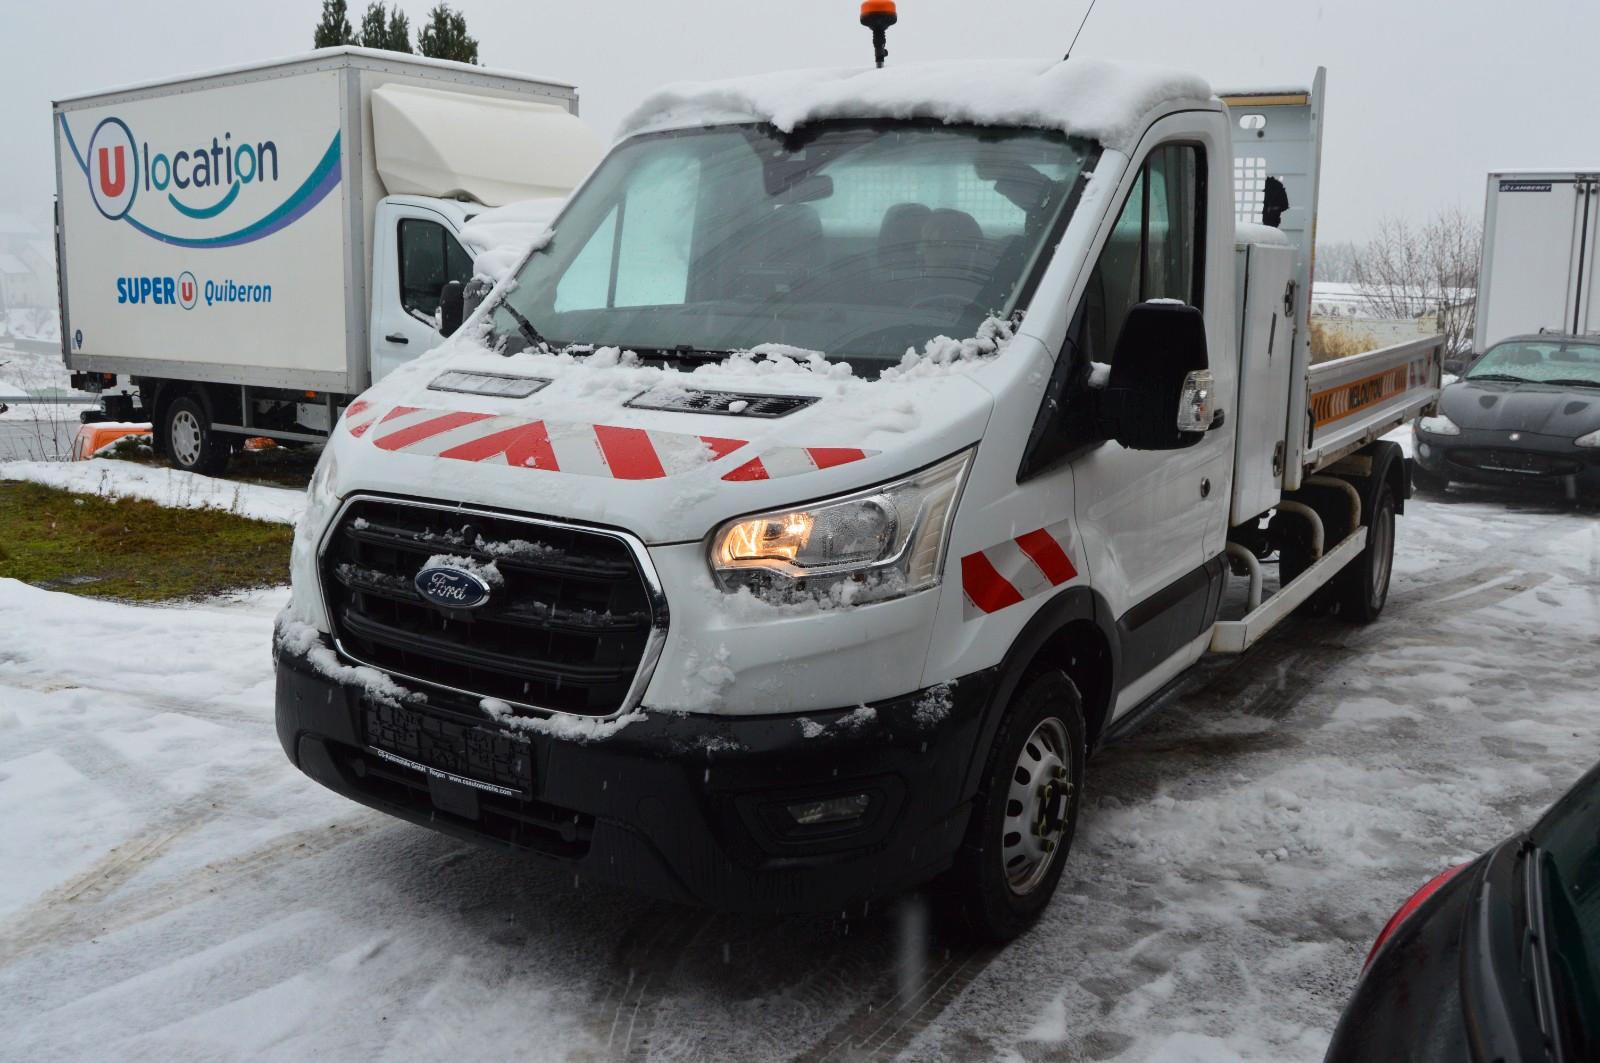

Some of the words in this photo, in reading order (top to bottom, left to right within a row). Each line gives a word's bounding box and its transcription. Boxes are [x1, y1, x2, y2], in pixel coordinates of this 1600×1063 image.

[98, 145, 126, 198] U
[143, 132, 279, 191] location
[116, 276, 177, 305] SUPER
[203, 280, 272, 306] Quiberon
[427, 572, 468, 600] Ford
